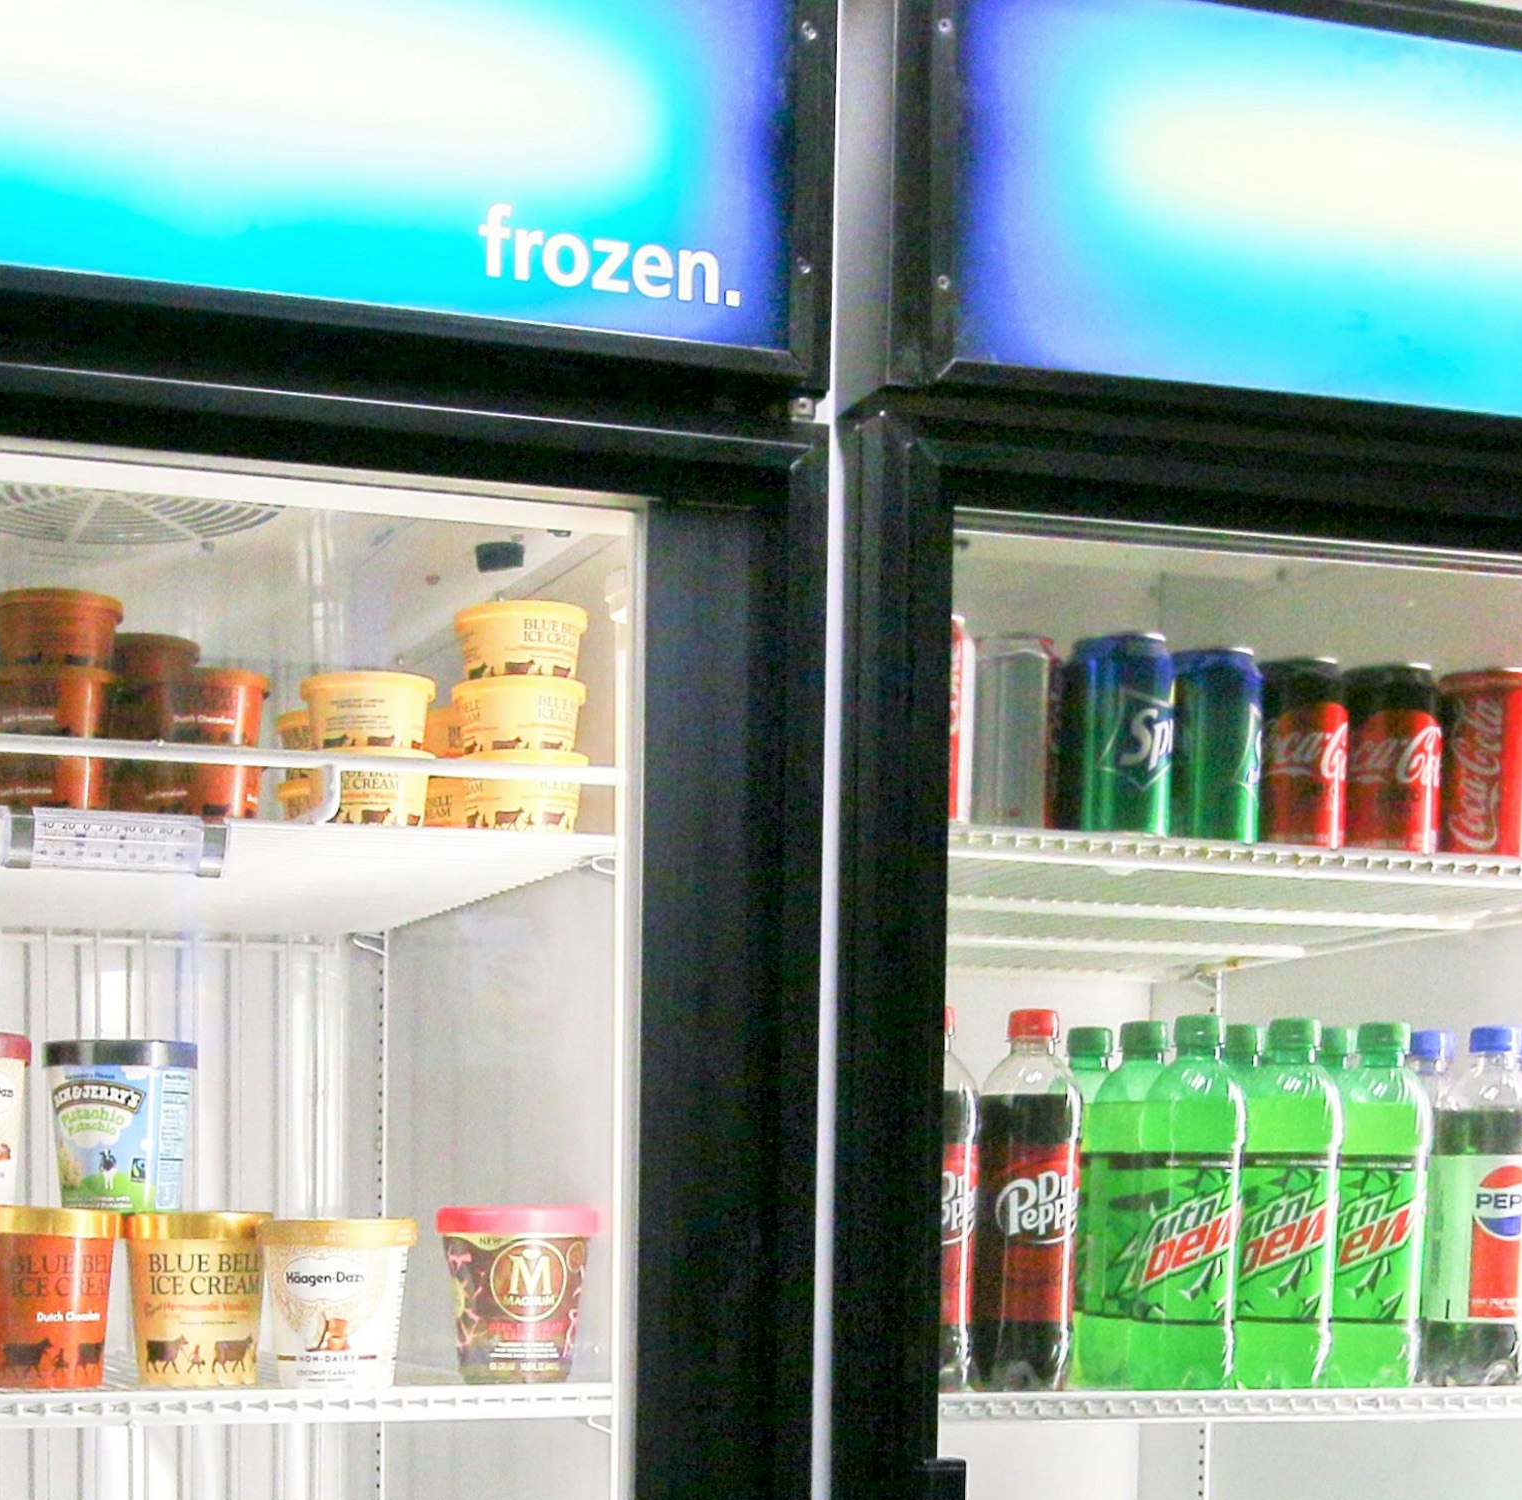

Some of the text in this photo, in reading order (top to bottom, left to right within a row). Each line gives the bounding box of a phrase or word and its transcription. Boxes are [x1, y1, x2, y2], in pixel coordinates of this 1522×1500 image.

[478, 202, 741, 308] frozen.
[1475, 1193, 1522, 1209] PEP
[148, 1252, 262, 1274] BLUE BELL
[150, 1275, 260, 1296] ICE CREAM
[36, 1311, 63, 1323] Dutch
[299, 1354, 355, 1362] NON-DAIRY
